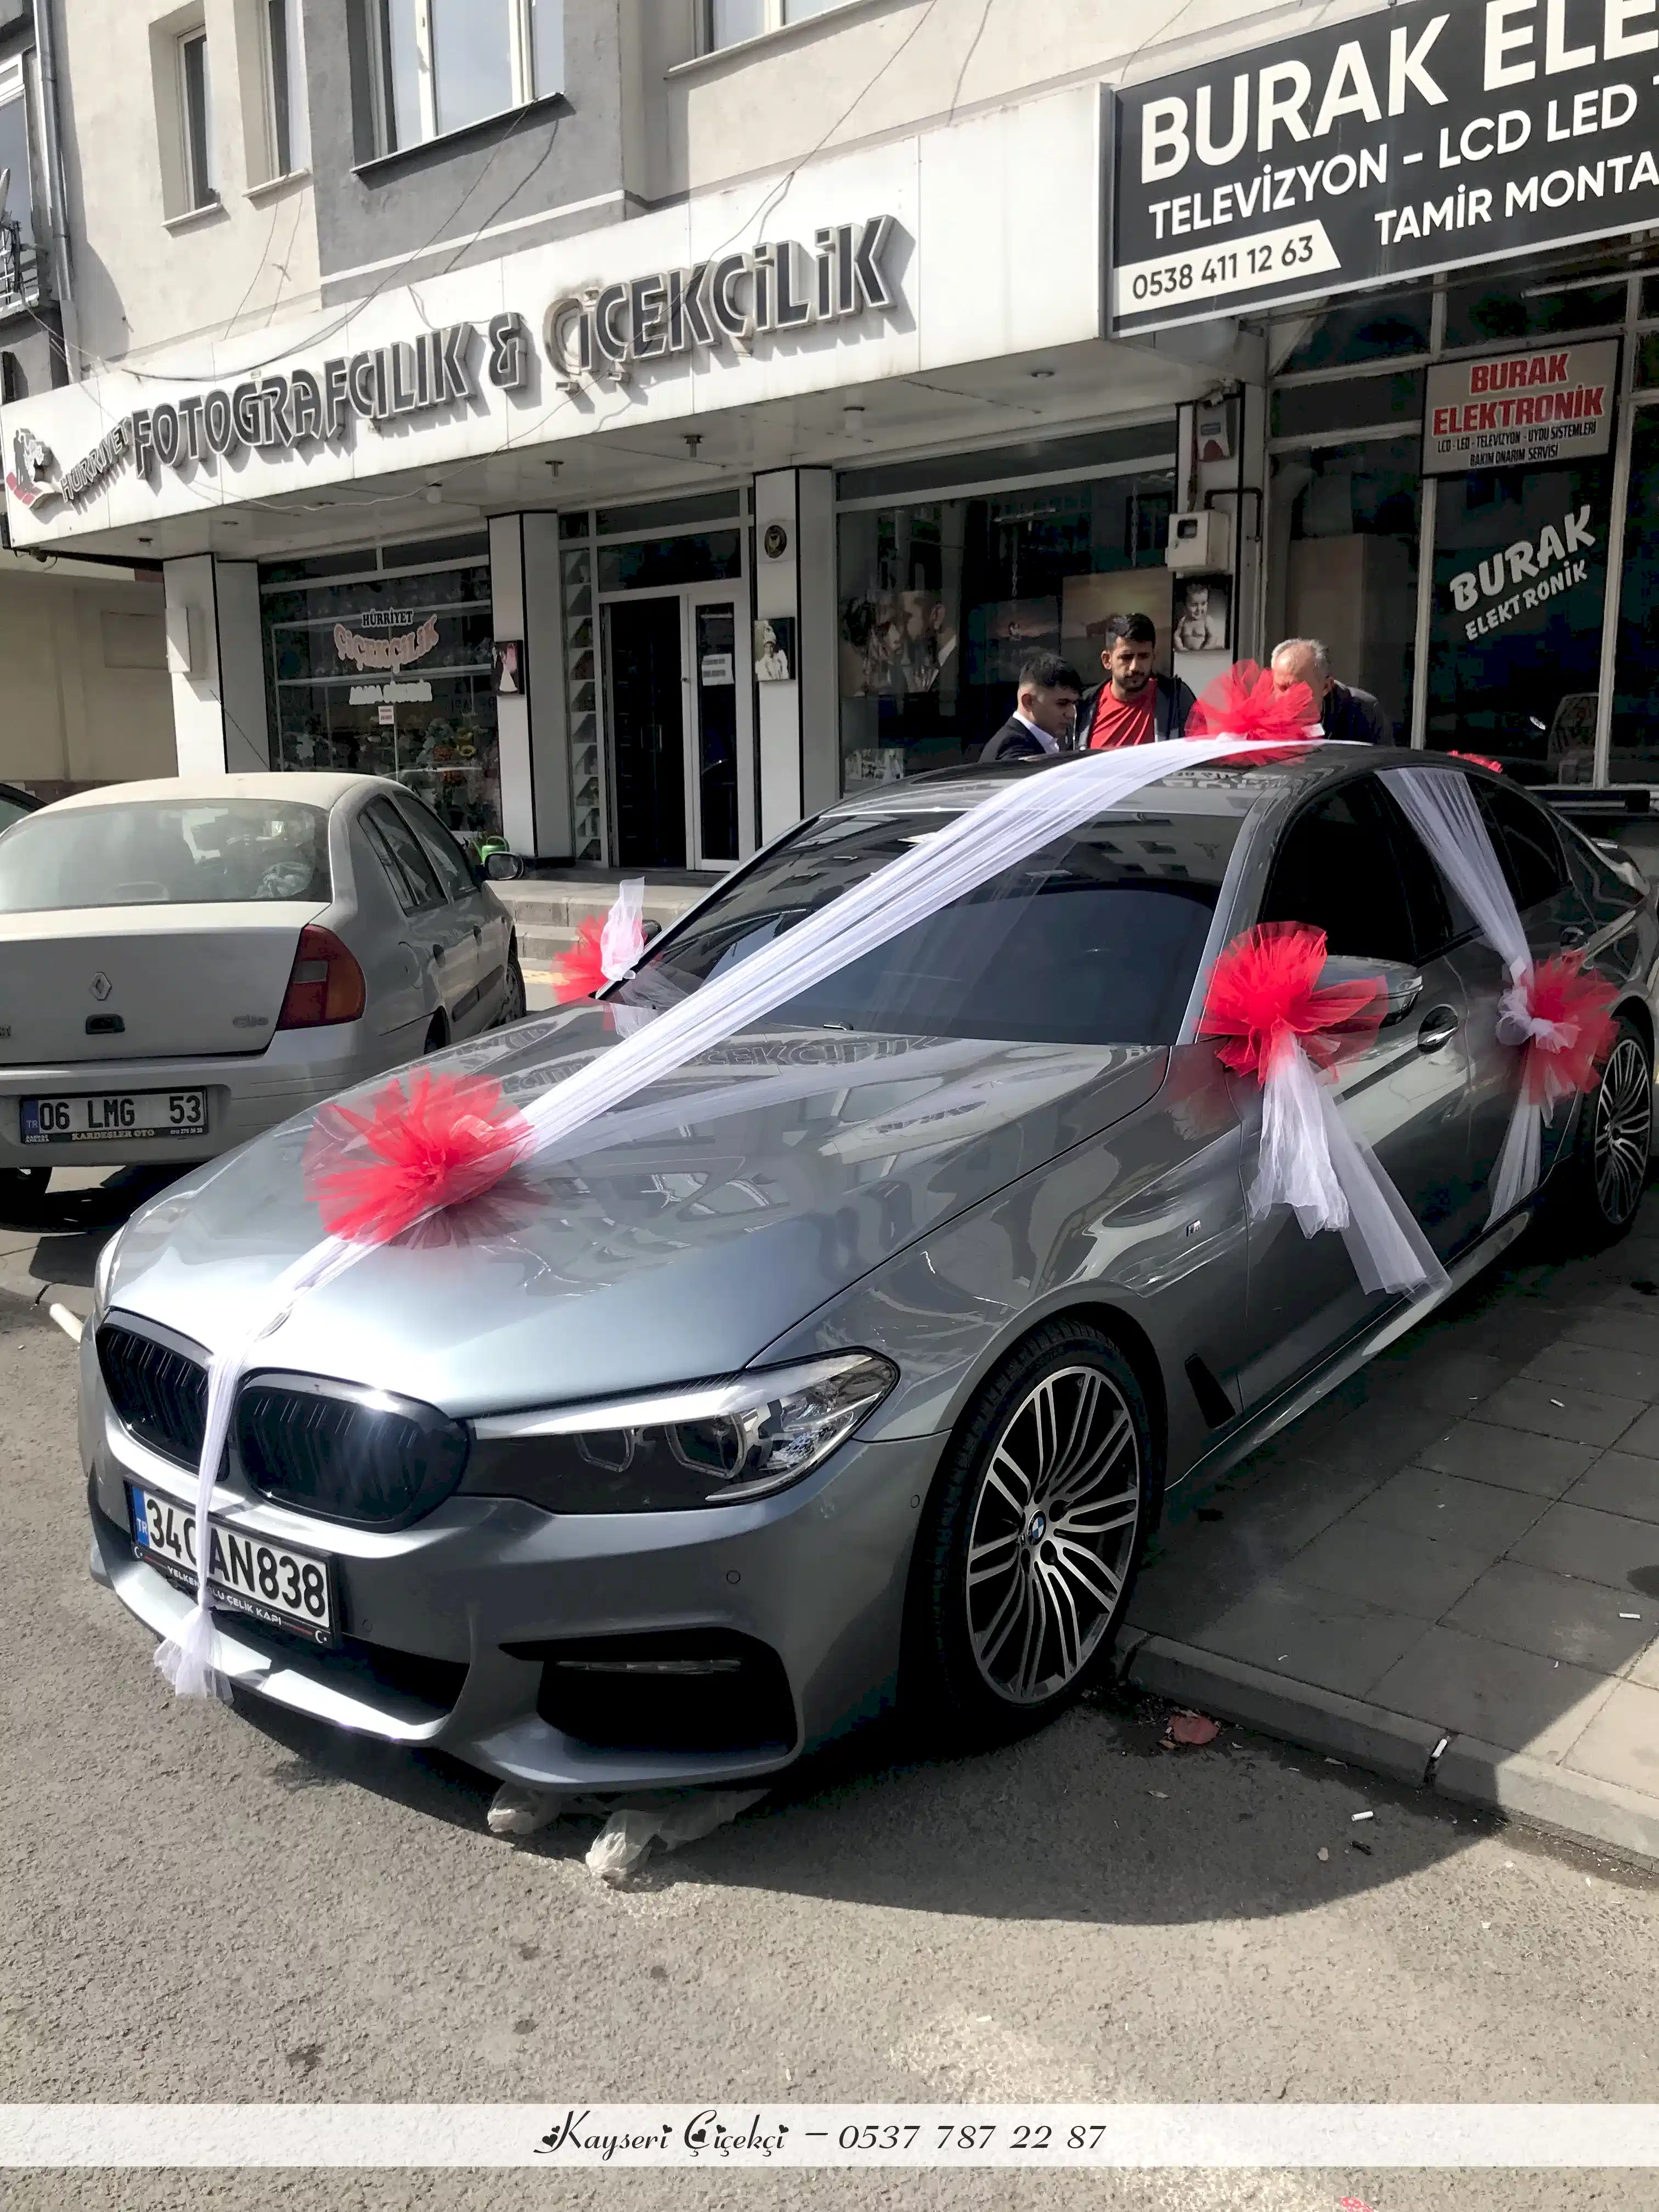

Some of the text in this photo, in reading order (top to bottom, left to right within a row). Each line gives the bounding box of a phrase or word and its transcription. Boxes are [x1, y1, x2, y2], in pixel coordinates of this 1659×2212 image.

[1141, 13, 1450, 184] BURAK
[1148, 143, 1388, 240] TELEVİZYON
[1439, 110, 1532, 169] LCD
[1547, 84, 1638, 143] LED
[1374, 184, 1492, 246] TAMİR
[1133, 235, 1313, 299] 0538 411 12 63
[488, 311, 528, 392] &
[1470, 353, 1570, 394] BURAK
[1432, 385, 1604, 436] ELEKTRONİK
[1449, 504, 1596, 612] BURAK
[363, 608, 413, 627] HÜRRİYET
[26, 1119, 38, 1129] TR
[40, 1095, 201, 1130] 06 LMG 53
[134, 1128, 156, 1138] OTO
[136, 1517, 148, 1535] TR
[226, 1594, 254, 1614] ÇELİK
